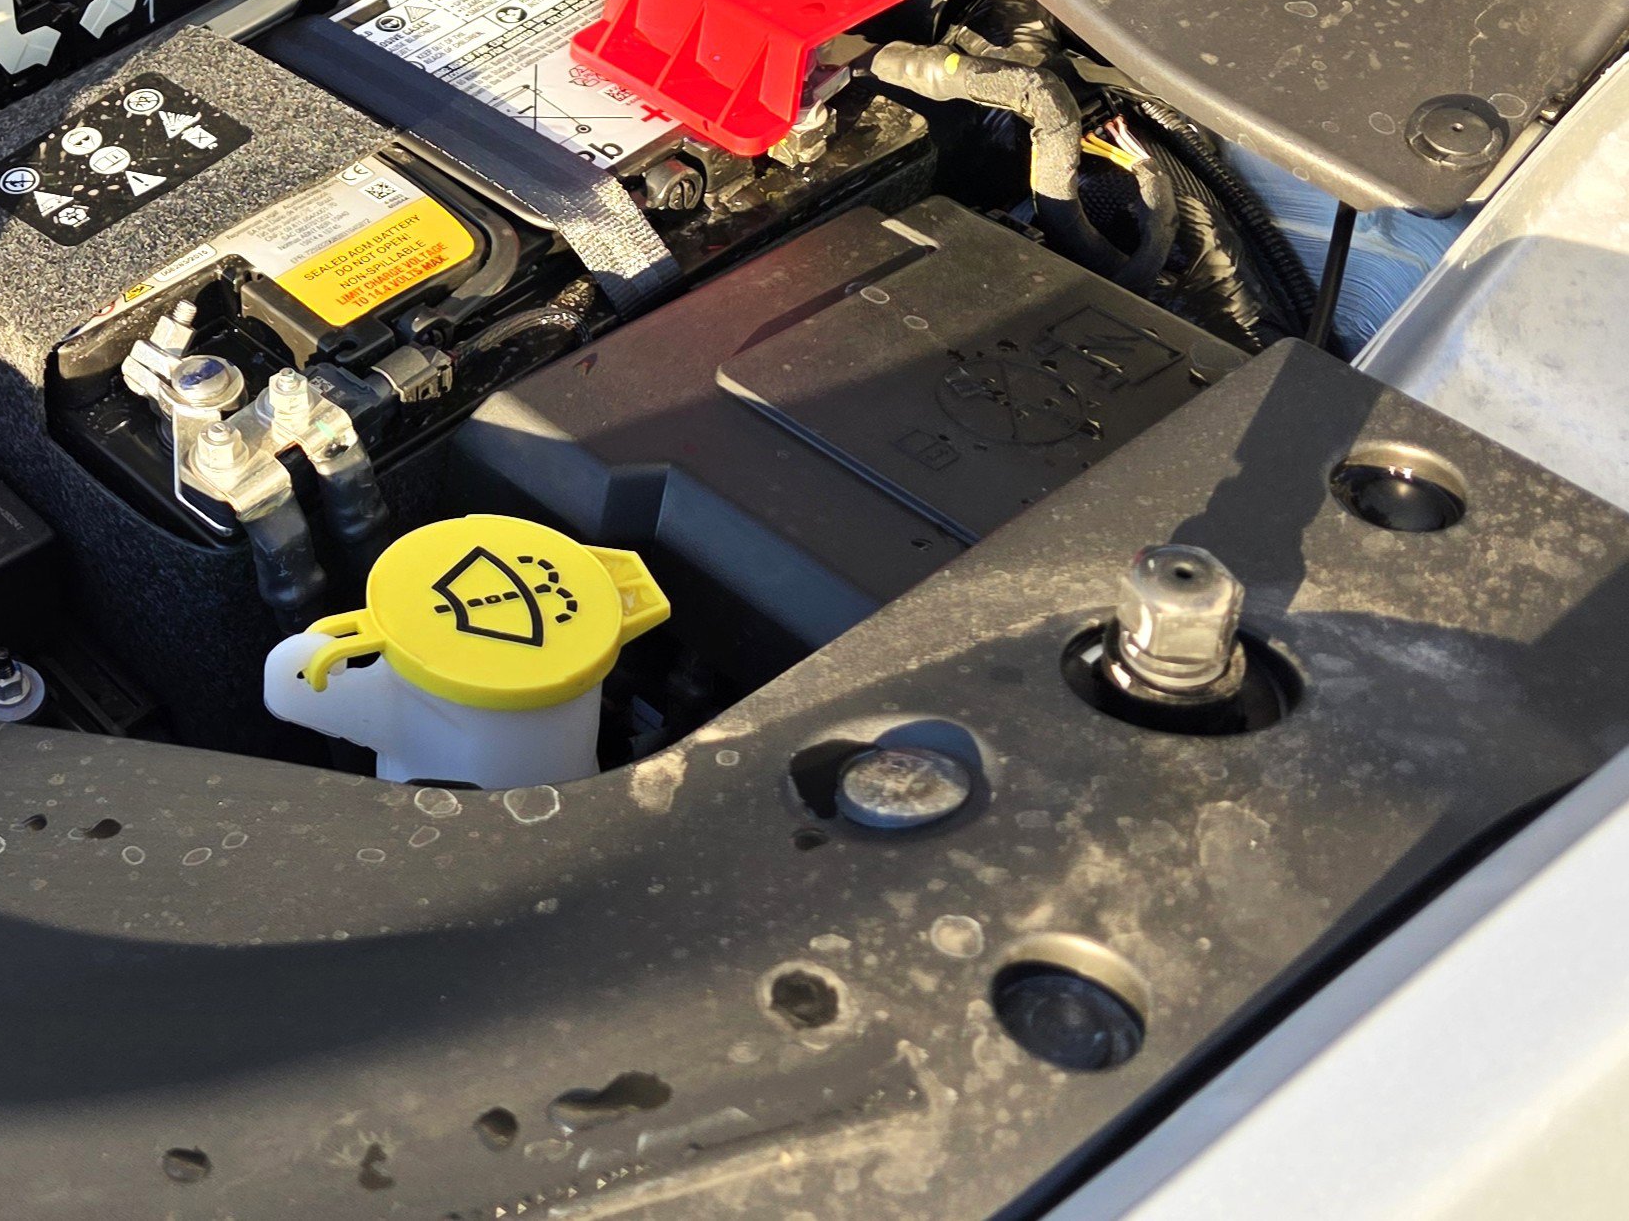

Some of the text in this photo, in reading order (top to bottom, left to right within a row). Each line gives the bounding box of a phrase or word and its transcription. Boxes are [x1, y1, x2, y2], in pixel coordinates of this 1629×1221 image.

[302, 253, 348, 281] SEALED
[346, 240, 374, 257] AGM
[371, 213, 421, 244] BATTERY
[333, 232, 411, 277] DO NOT OPEN!
[335, 240, 447, 305] LIMIT CHARGE VOLTAGE
[339, 237, 426, 291] NON-SPILLABLE
[351, 252, 449, 308] TO 14.4 VOLTS MAX.
